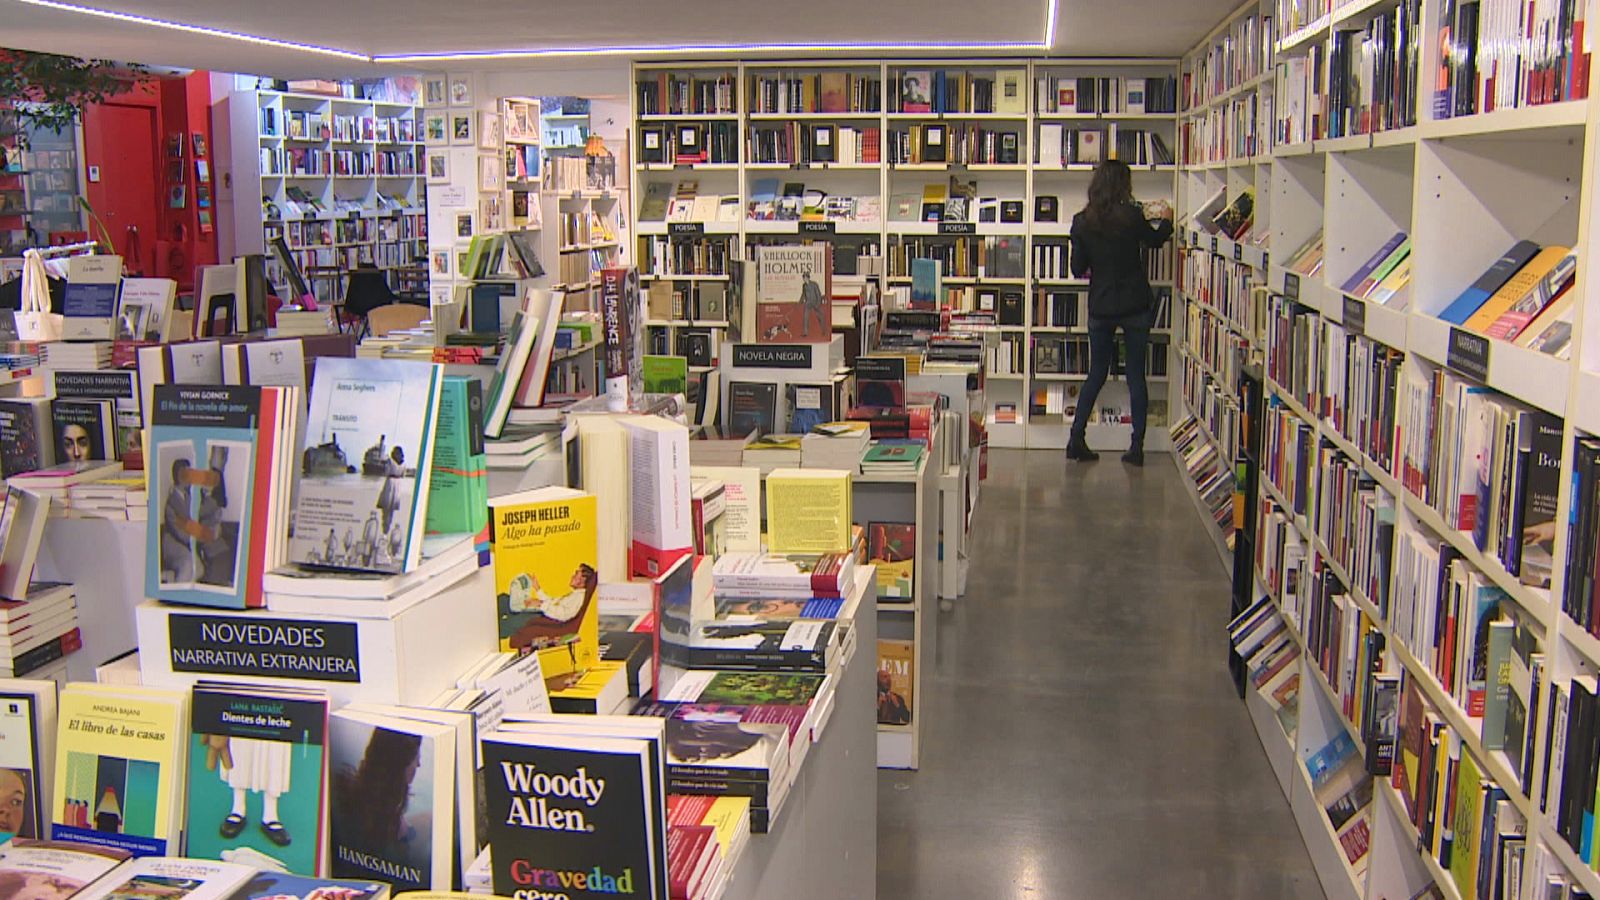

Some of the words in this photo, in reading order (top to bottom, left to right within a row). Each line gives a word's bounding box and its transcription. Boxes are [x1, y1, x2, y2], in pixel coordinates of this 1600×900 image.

[764, 251, 812, 260] SHERLOCK
[764, 262, 813, 274] HOLMES
[604, 295, 619, 345] LAWRENCE
[739, 351, 774, 361] NOVELA
[775, 352, 806, 361] NEGRA
[56, 376, 94, 385] NOVEDADES
[95, 376, 130, 385] NARRATIVA
[352, 383, 376, 393] Seghers
[180, 391, 200, 400] VIVIAN
[201, 391, 230, 400] GORNICK
[194, 402, 218, 412] novela
[228, 404, 248, 413] amor
[502, 509, 537, 526] JOSEPH
[538, 506, 570, 521] HELLER
[502, 525, 527, 541] Algo
[528, 524, 542, 536] ha
[543, 519, 581, 538] pasado
[201, 622, 325, 649] NOVEDADES
[173, 648, 257, 668] NARRATIVA
[261, 653, 357, 674] EXTRANJERA
[92, 704, 118, 715] ANDREA
[119, 706, 141, 717] BAJANI
[230, 702, 250, 712] LANA
[222, 711, 255, 725] Dientes
[255, 714, 267, 726] de
[267, 715, 292, 729] leche
[68, 719, 80, 731] El
[81, 720, 105, 734] libro
[105, 723, 119, 736] de
[120, 725, 136, 739] las
[136, 730, 166, 742] casas
[500, 761, 606, 806] Woody
[338, 845, 422, 884] HANGSAMAN
[510, 859, 635, 895] Gravedad
